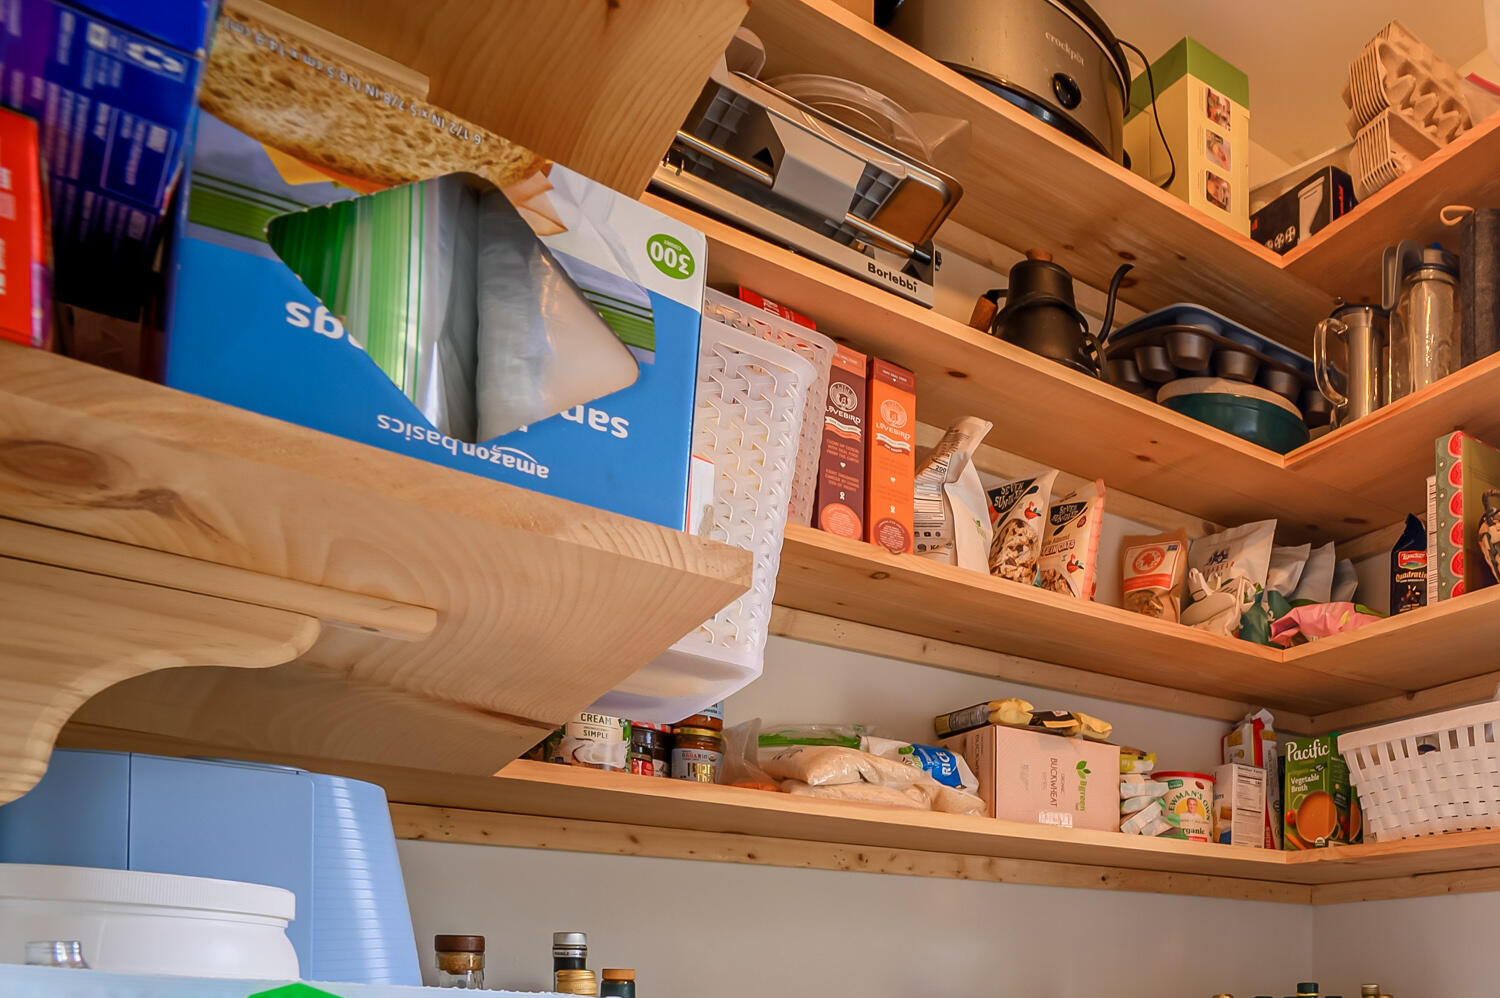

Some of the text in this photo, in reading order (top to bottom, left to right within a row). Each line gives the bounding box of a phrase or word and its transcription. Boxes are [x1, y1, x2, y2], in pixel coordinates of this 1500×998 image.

[449, 122, 470, 141] 1/2
[473, 133, 482, 146] 6
[651, 240, 691, 275] 300
[868, 261, 918, 293] Borlebbi
[580, 713, 612, 725] CREAM
[1285, 739, 1330, 762] Pacific
[935, 751, 953, 776] RICE
[1290, 773, 1320, 786] Vegetable
[1290, 784, 1308, 793] Broth
[1168, 790, 1203, 811] EWMAN'S
[1182, 827, 1205, 835] rganic
